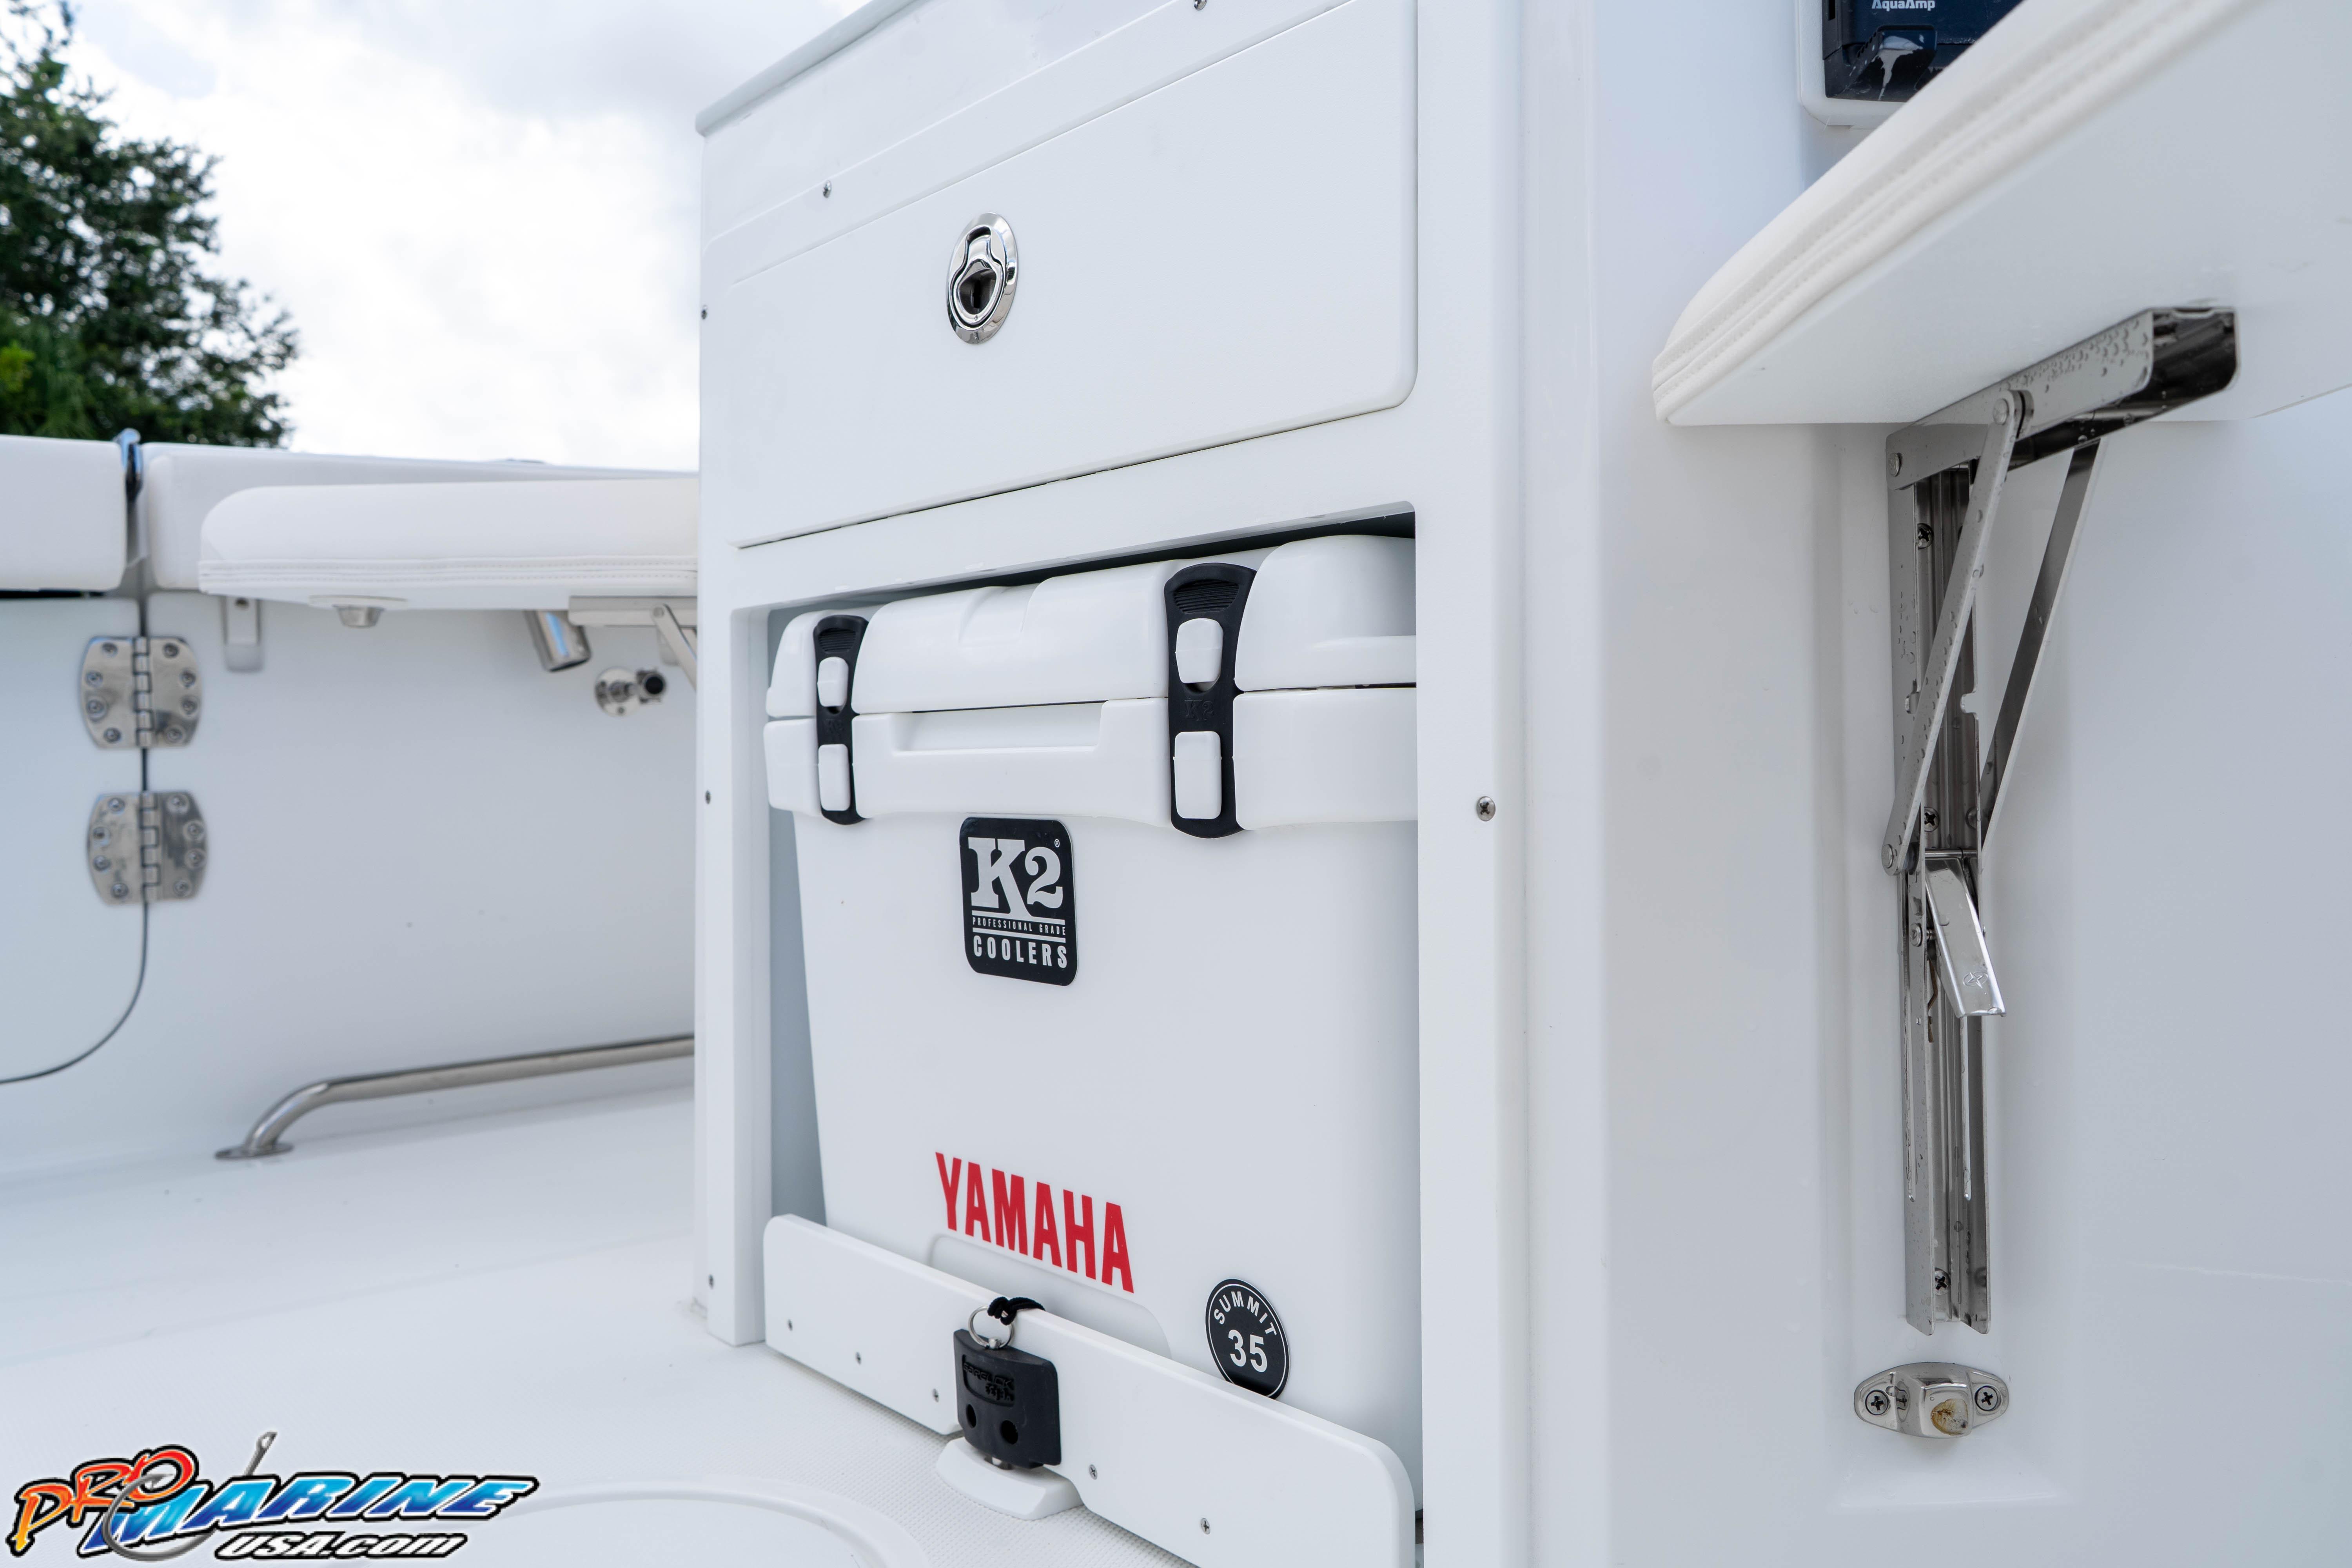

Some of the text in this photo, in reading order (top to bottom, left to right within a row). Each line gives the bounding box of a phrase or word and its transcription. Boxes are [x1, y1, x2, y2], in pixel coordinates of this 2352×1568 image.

[973, 916, 1066, 935] PROFESSIONAL GRADE
[973, 935, 1067, 968] COOLERS
[935, 1152, 1134, 1294] YAMAHA
[1214, 1291, 1277, 1336] SUMMIT
[1228, 1329, 1267, 1373] 35
